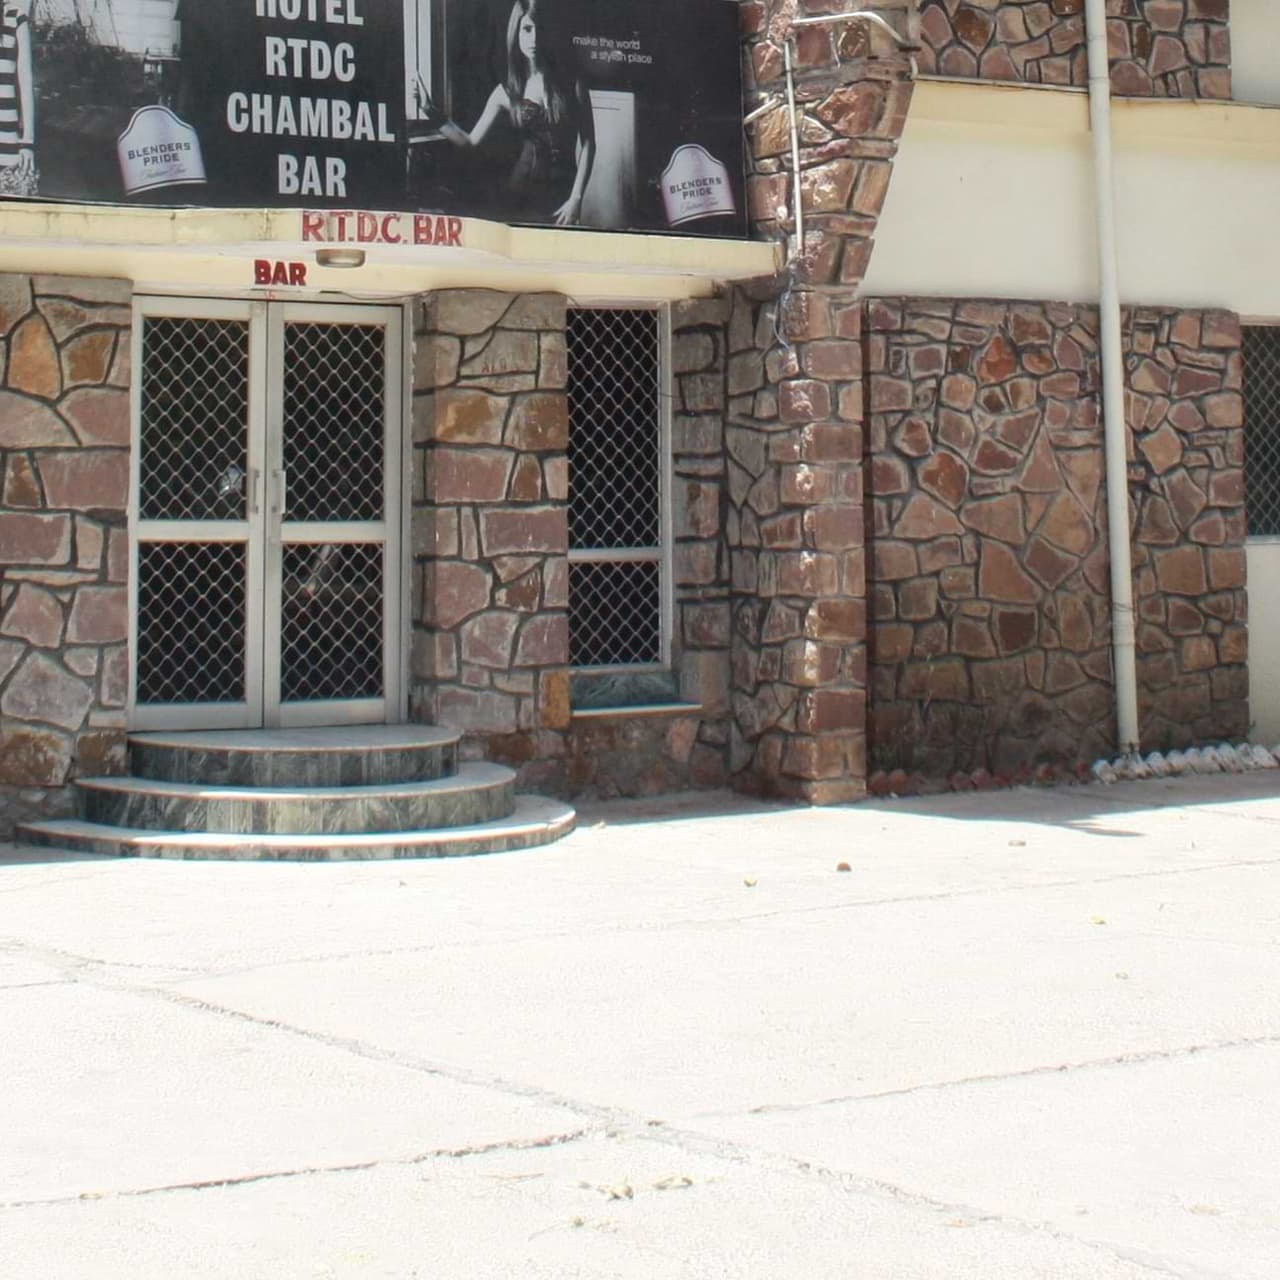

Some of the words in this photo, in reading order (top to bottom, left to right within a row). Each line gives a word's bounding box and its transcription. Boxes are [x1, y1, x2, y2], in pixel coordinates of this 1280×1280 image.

[572, 34, 599, 47] make
[600, 36, 615, 49] the
[615, 38, 641, 51] world
[265, 36, 356, 83] RTDC
[627, 51, 653, 64] place
[226, 91, 396, 143] CHAMBAL
[127, 142, 191, 160] BLENDERS
[143, 153, 180, 167] PRIDE
[278, 154, 347, 198] BAR
[669, 177, 723, 195] BLENDERS
[682, 187, 713, 201] PRIDE
[413, 214, 463, 246] BAR
[254, 259, 307, 287] BAR
